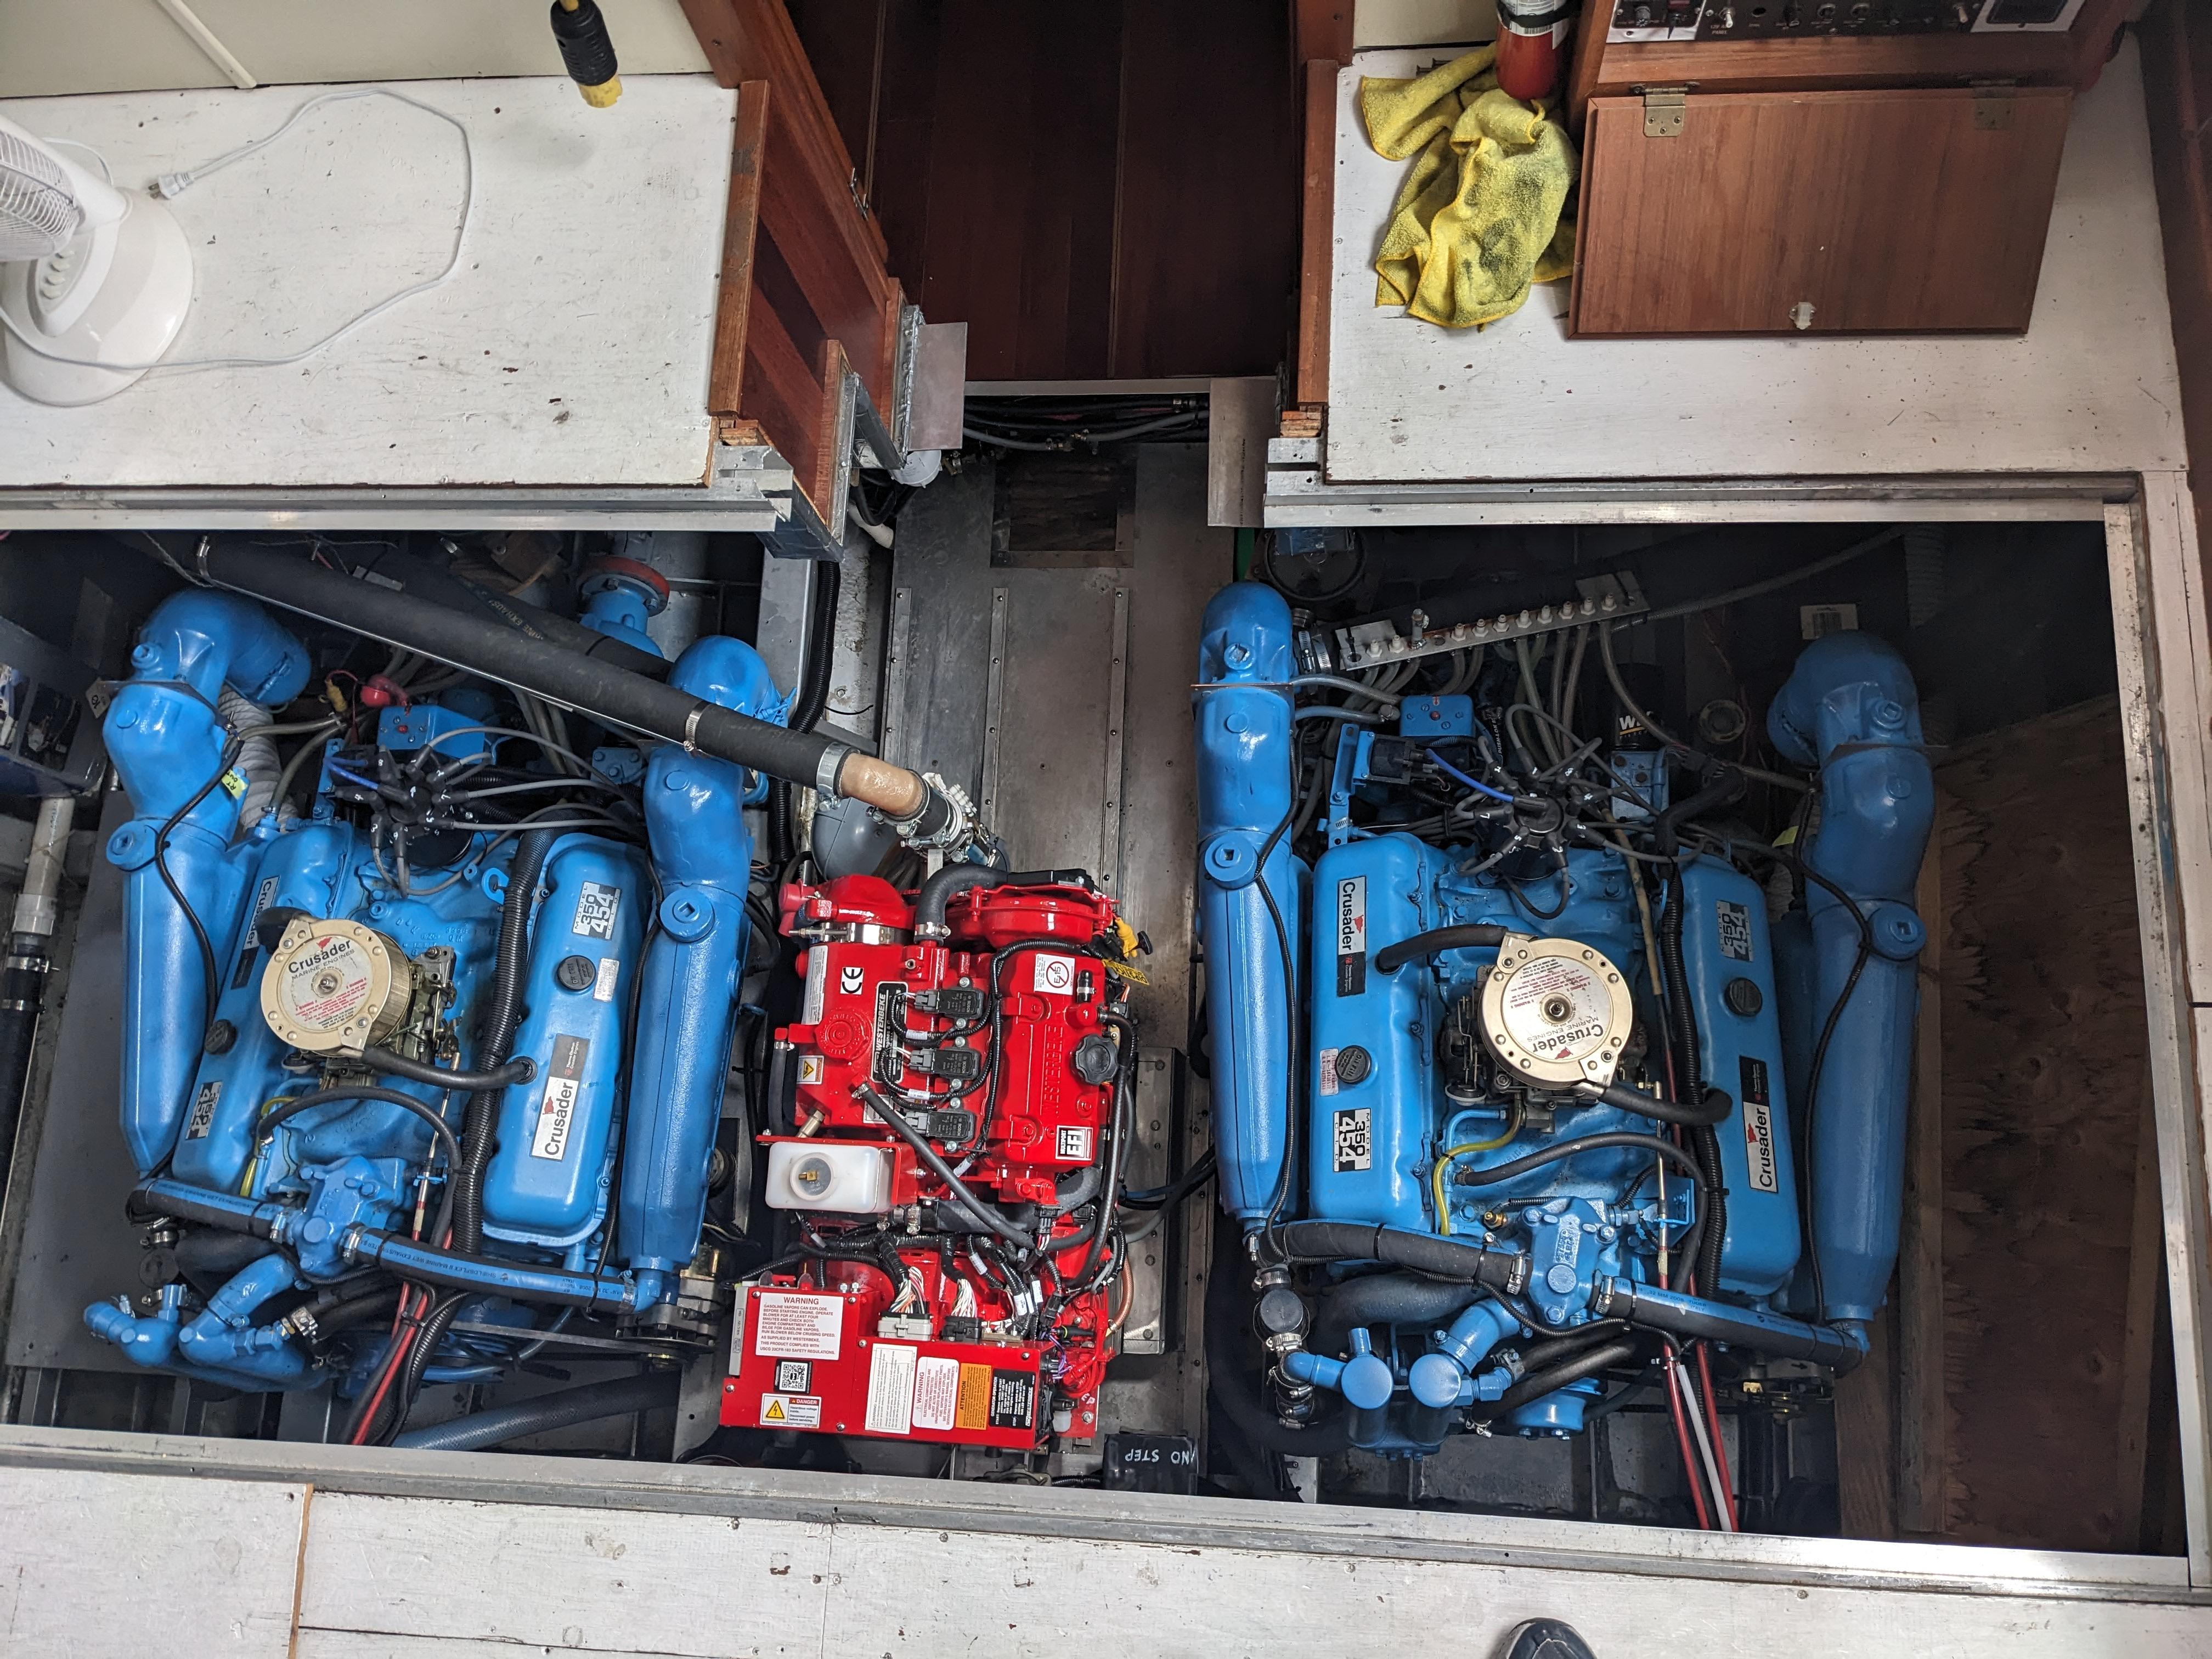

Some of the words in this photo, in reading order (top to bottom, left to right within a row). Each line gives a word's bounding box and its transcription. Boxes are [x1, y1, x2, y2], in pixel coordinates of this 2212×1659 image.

[226, 781, 236, 790] RT
[247, 881, 272, 946] Cruser
[575, 885, 588, 929] MODEL
[581, 894, 596, 925] 350
[590, 892, 614, 933] 454
[1342, 882, 1356, 951] Crusader
[1722, 913, 1734, 946] 350
[1730, 911, 1747, 955] 454
[289, 940, 351, 973] Crusader
[292, 966, 320, 979] MARINE
[324, 949, 355, 967] ENGINES
[842, 968, 863, 994] CE
[876, 993, 885, 1051] WESTERBEKE
[1527, 1027, 1563, 1042] ENGINES
[1532, 1024, 1603, 1053] Crusader
[1567, 1016, 1599, 1030] MARINE
[1044, 1026, 1063, 1118] WESTERBEKE
[191, 1089, 210, 1131] 454
[544, 1082, 573, 1155] Crusader
[1066, 1130, 1083, 1155] EFI
[1340, 1117, 1355, 1163] 454
[1355, 1121, 1365, 1156] 350
[1756, 1108, 1772, 1187] Crusader
[426, 1260, 448, 1268] MARINE
[1125, 1449, 1159, 1463] STEP
[1171, 1451, 1189, 1465] NO
